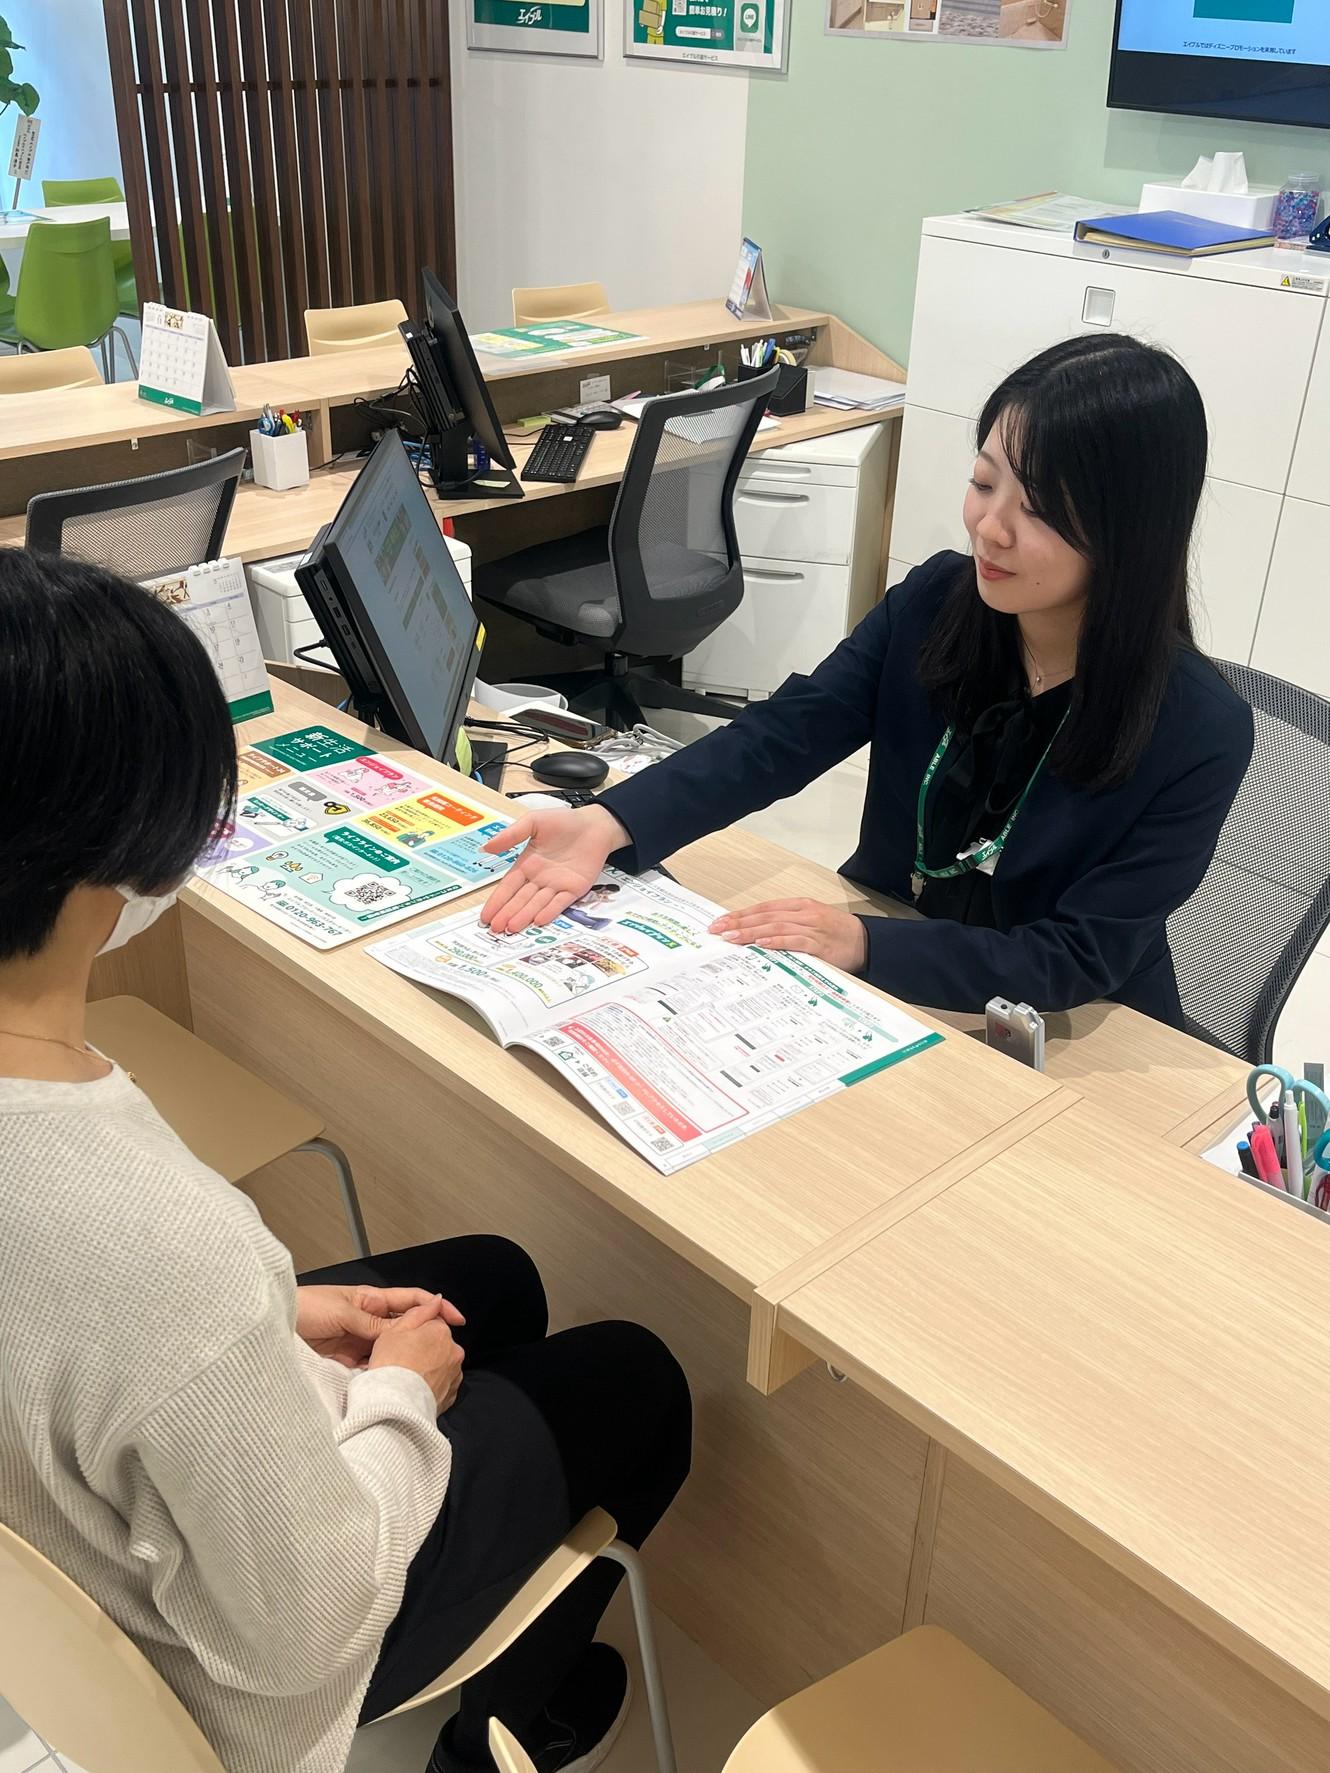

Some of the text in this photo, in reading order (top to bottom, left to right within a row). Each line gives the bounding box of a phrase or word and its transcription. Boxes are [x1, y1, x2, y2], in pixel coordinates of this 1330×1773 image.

[274, 741, 321, 763] メニュー
[287, 736, 336, 758] サポート
[302, 730, 358, 754] 新生活
[930, 752, 940, 771] ABLE
[1001, 824, 1012, 841] ABLE
[621, 877, 674, 905] エンジョイプラン
[283, 904, 343, 936] 0120-963-767
